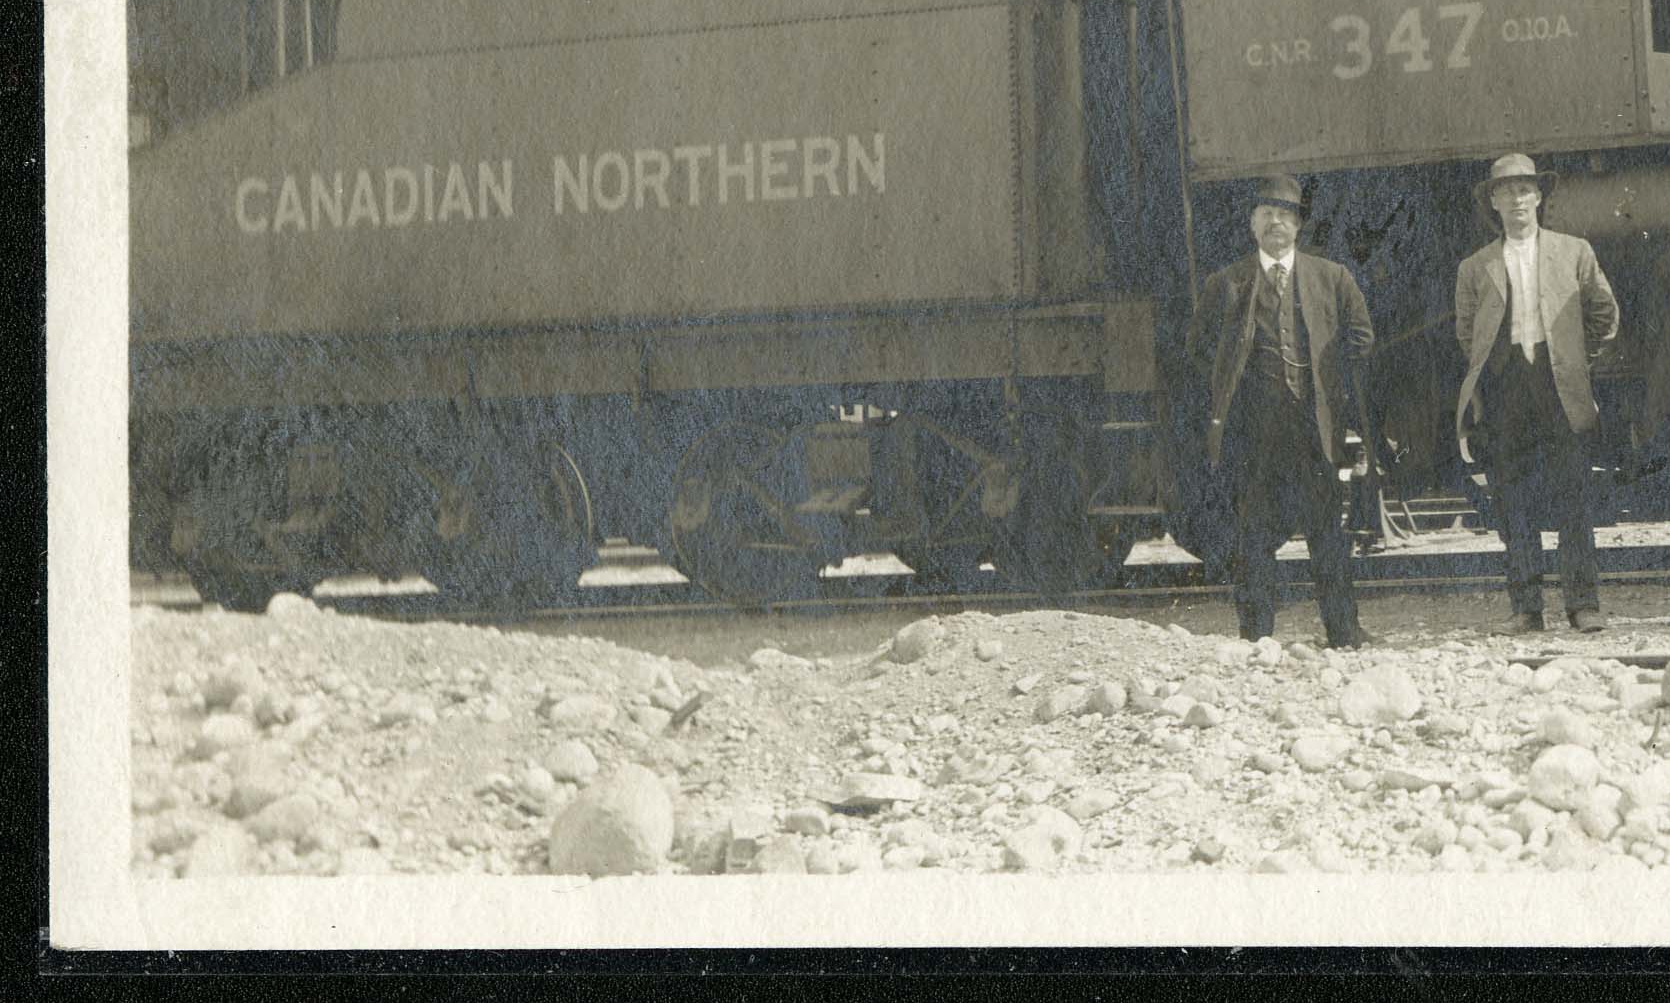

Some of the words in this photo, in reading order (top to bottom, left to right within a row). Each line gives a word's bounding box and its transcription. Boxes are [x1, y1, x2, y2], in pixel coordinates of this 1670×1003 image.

[1328, 1, 1486, 80] 347
[234, 159, 514, 233] CANADIAN
[553, 132, 886, 216] NORTHERN
